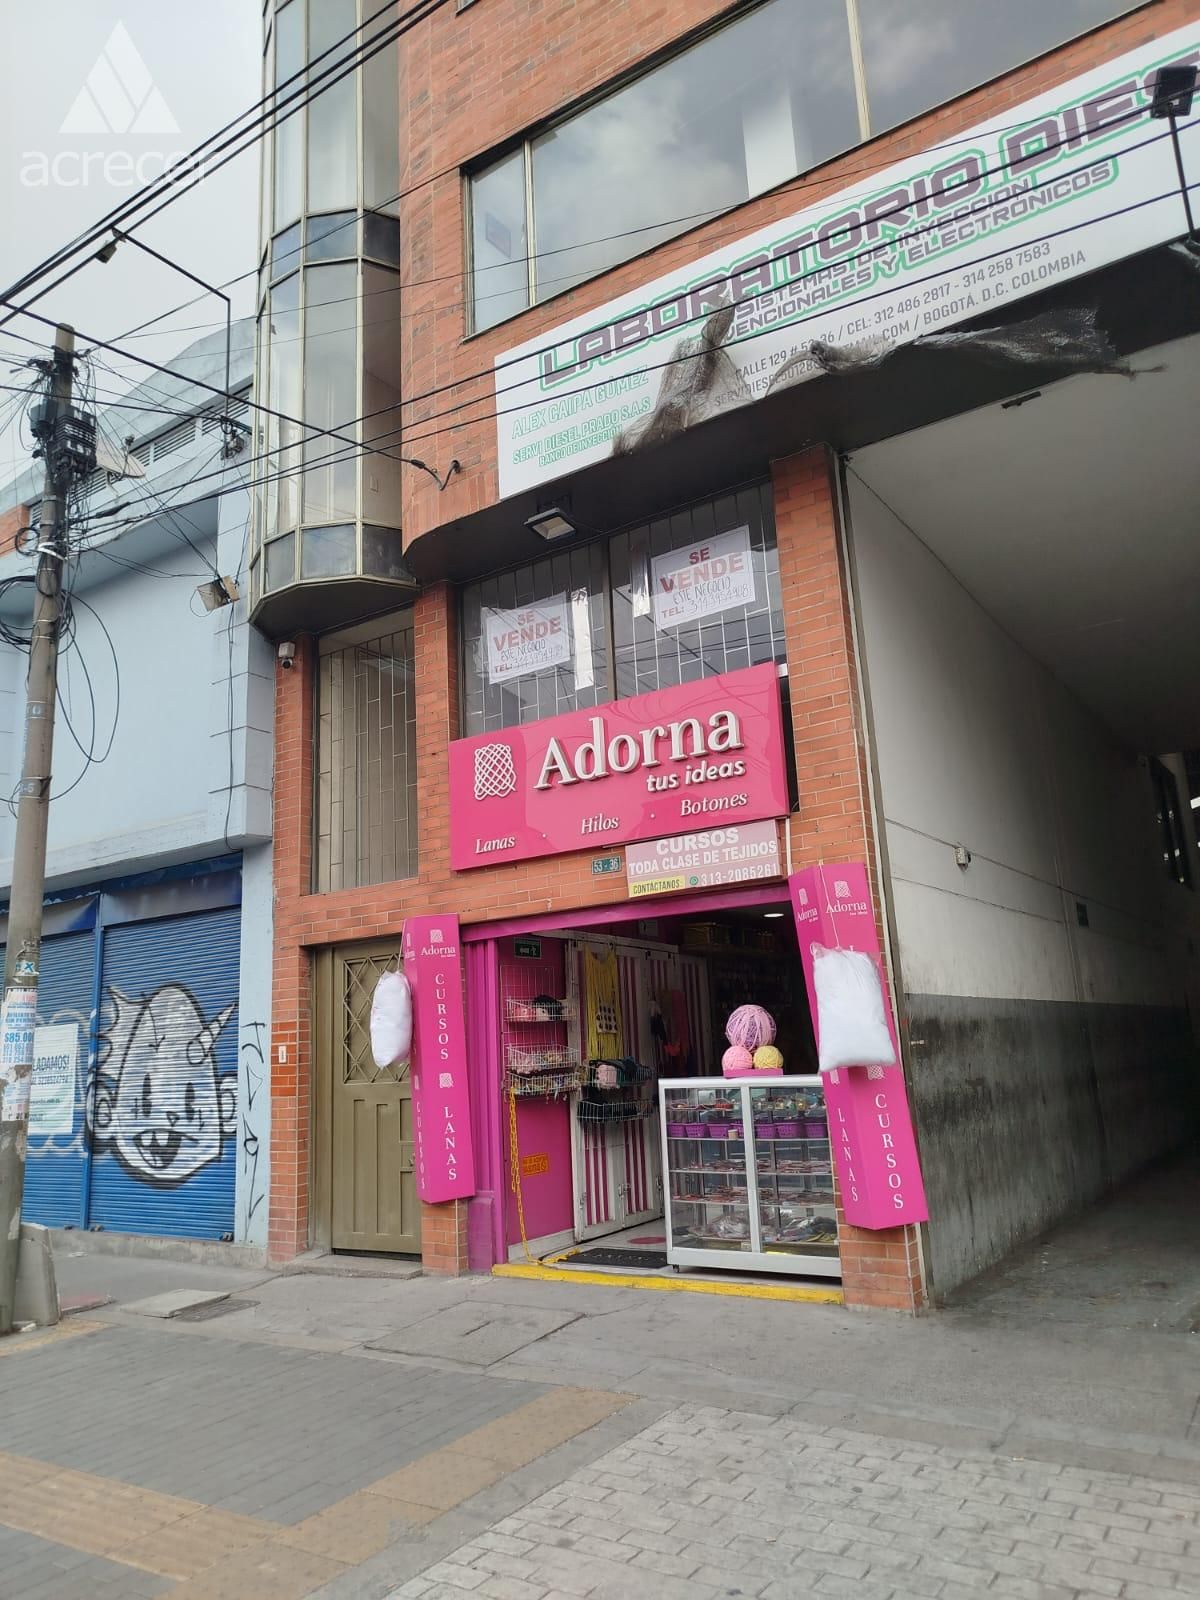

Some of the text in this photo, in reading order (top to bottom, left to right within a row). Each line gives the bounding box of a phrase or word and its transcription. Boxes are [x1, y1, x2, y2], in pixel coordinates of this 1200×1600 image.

[543, 155, 983, 387] LABORATORIO
[736, 261, 849, 319] SISTEMAS
[856, 241, 891, 268] DE
[880, 256, 897, 272] Y
[982, 282, 1009, 301] D.C.
[1011, 250, 1087, 290] COLOMBIA
[769, 350, 787, 367] 129
[847, 316, 872, 335] CEL:
[874, 307, 894, 324] 312
[897, 296, 921, 315] 486
[923, 283, 951, 304] 2817
[963, 269, 985, 288] 314
[988, 257, 1014, 278] 258
[1015, 242, 1051, 265] 7583
[512, 408, 547, 439] ALEX
[550, 391, 594, 423] CAIPA
[513, 445, 545, 464] SERVI
[544, 426, 582, 453] DIESEL
[581, 412, 621, 437] PRADO
[539, 447, 567, 467] BANCO
[660, 552, 745, 593] VENDE
[688, 547, 710, 565] SE
[493, 615, 561, 652] VENDE
[517, 609, 535, 626] SE
[661, 606, 685, 618] TEL:
[533, 709, 745, 791] Adorna
[646, 760, 746, 792] tus ideas
[475, 791, 748, 855] Lanas Hilos Botones
[656, 827, 739, 855] CURSOS
[629, 840, 777, 876] TODA CLASE DE TEJIDOS
[825, 899, 867, 914] Adorna
[420, 944, 456, 956] Adorna
[434, 973, 449, 1060] CURSOS
[443, 1106, 457, 1181] LANAS
[837, 1107, 859, 1202] LANAS
[875, 1093, 904, 1209] CURSOS
